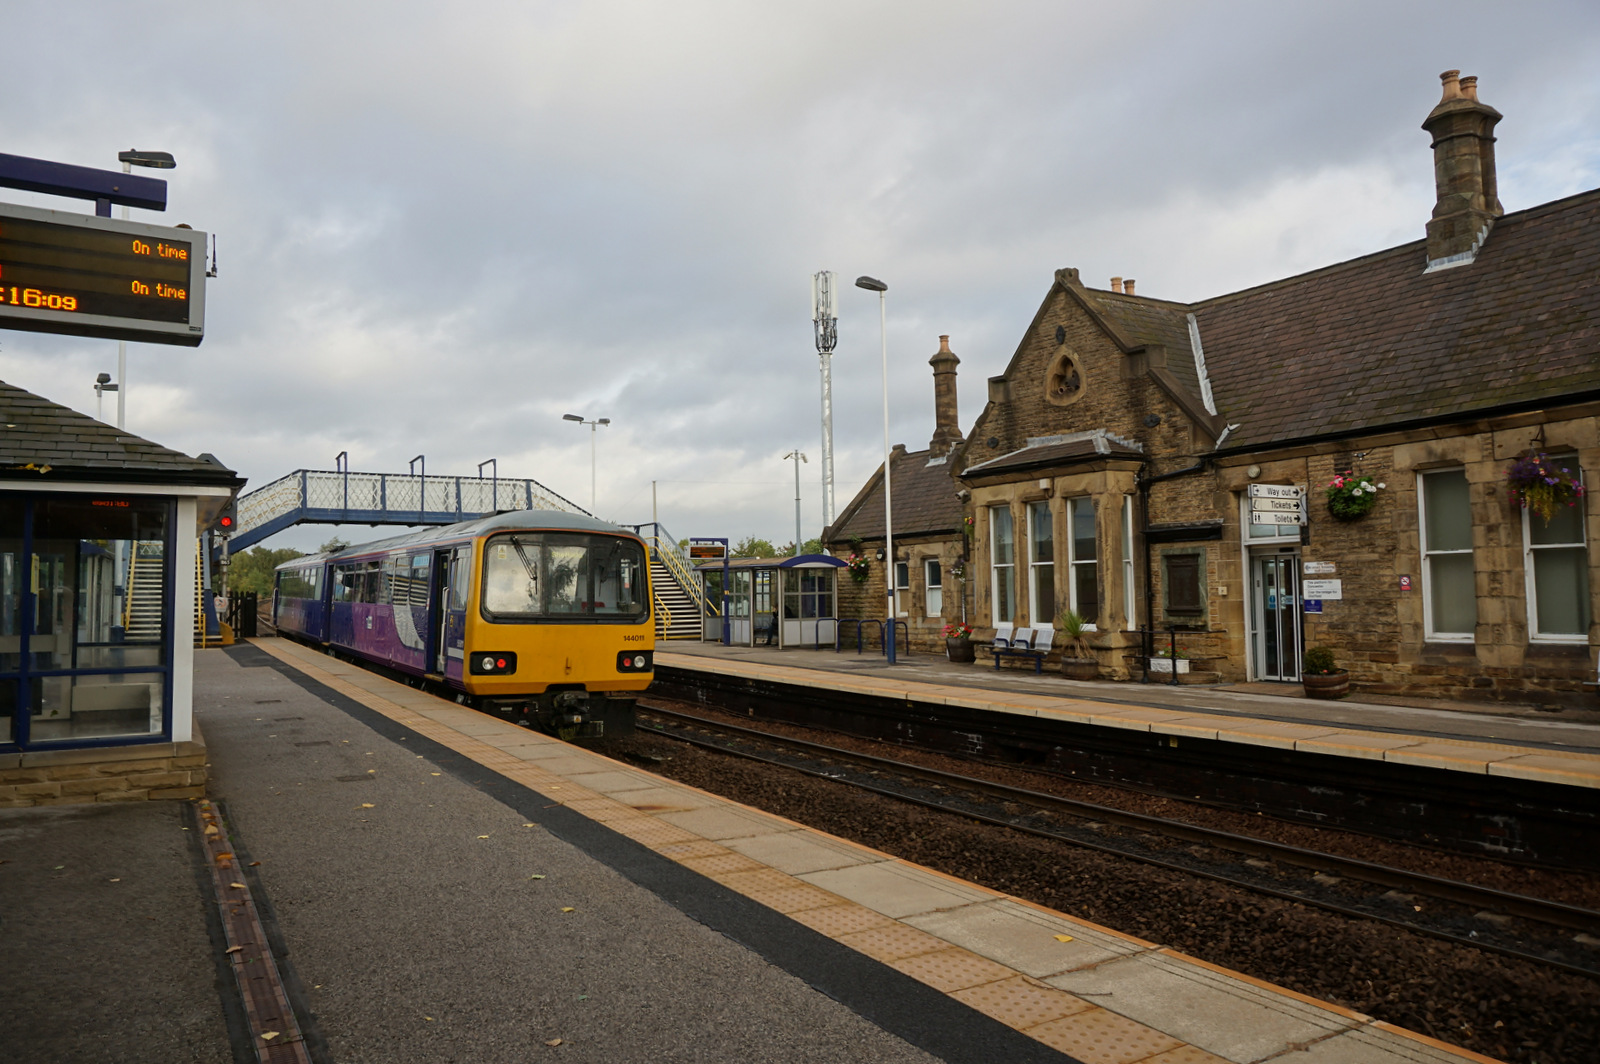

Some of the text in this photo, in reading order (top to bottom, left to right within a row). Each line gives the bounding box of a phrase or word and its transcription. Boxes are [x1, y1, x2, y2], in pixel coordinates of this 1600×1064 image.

[132, 240, 187, 260] On time
[131, 280, 186, 300] On time
[1266, 487, 1292, 497] Way out
[1270, 500, 1292, 510] Tickets
[1274, 514, 1293, 523] Toilets
[623, 634, 645, 642] 144011
